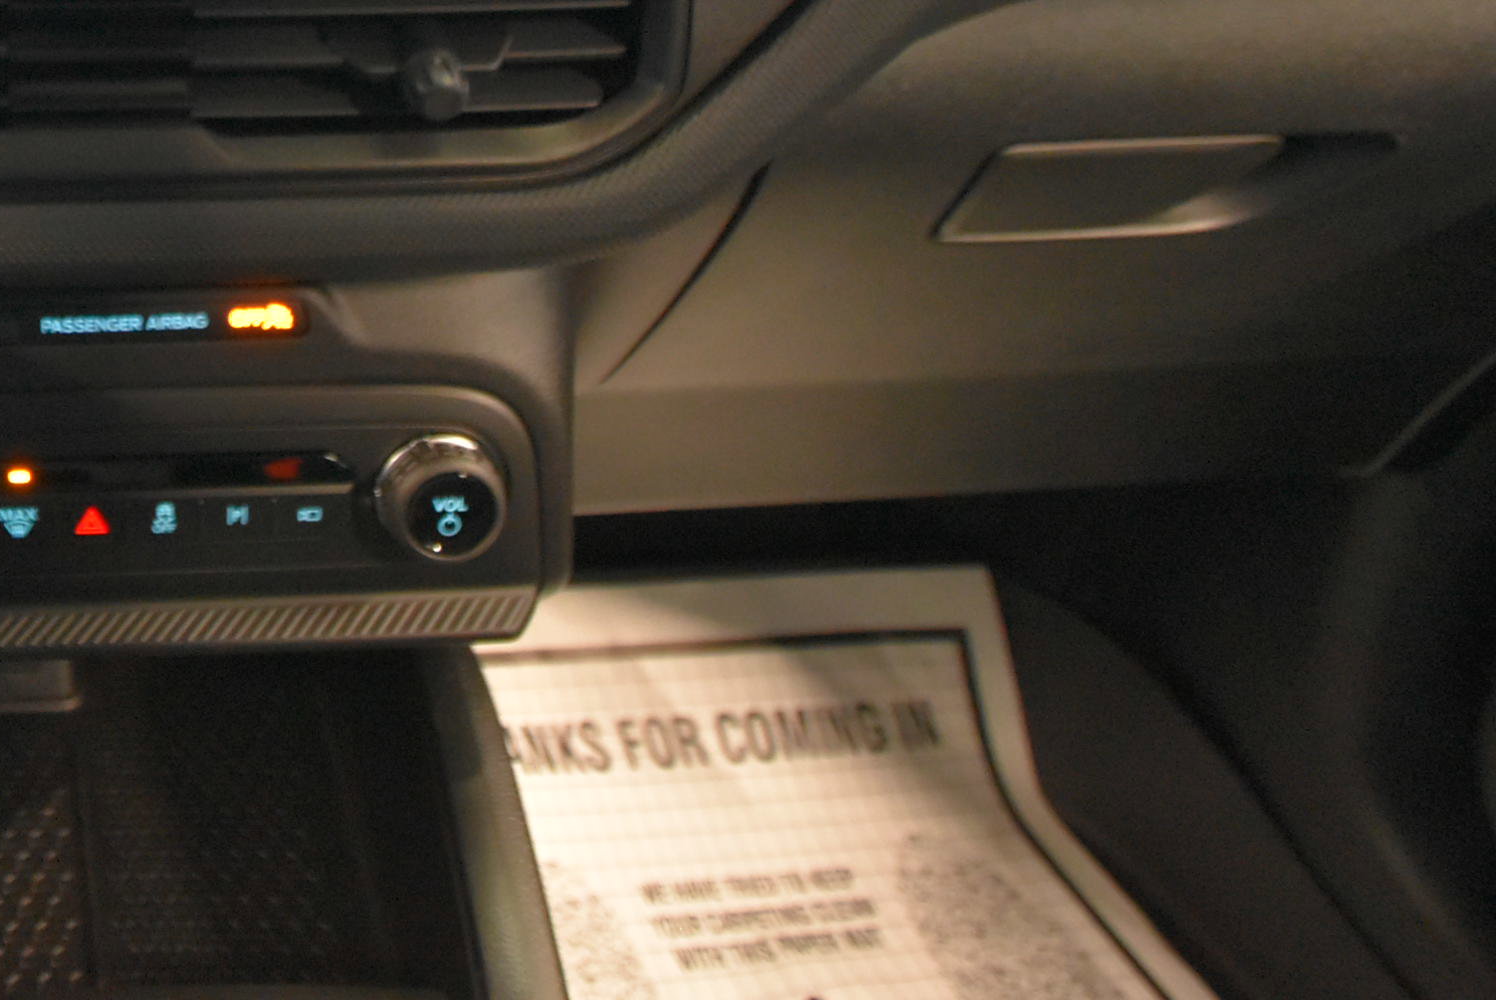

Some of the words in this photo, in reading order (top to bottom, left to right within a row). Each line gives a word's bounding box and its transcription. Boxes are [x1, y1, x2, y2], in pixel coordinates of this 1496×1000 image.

[40, 314, 144, 334] PASSENGER
[145, 311, 210, 331] AIRBAG
[432, 496, 469, 513] VOL
[616, 716, 710, 769] FOR
[715, 703, 890, 764] COMING
[896, 697, 940, 746] IN
